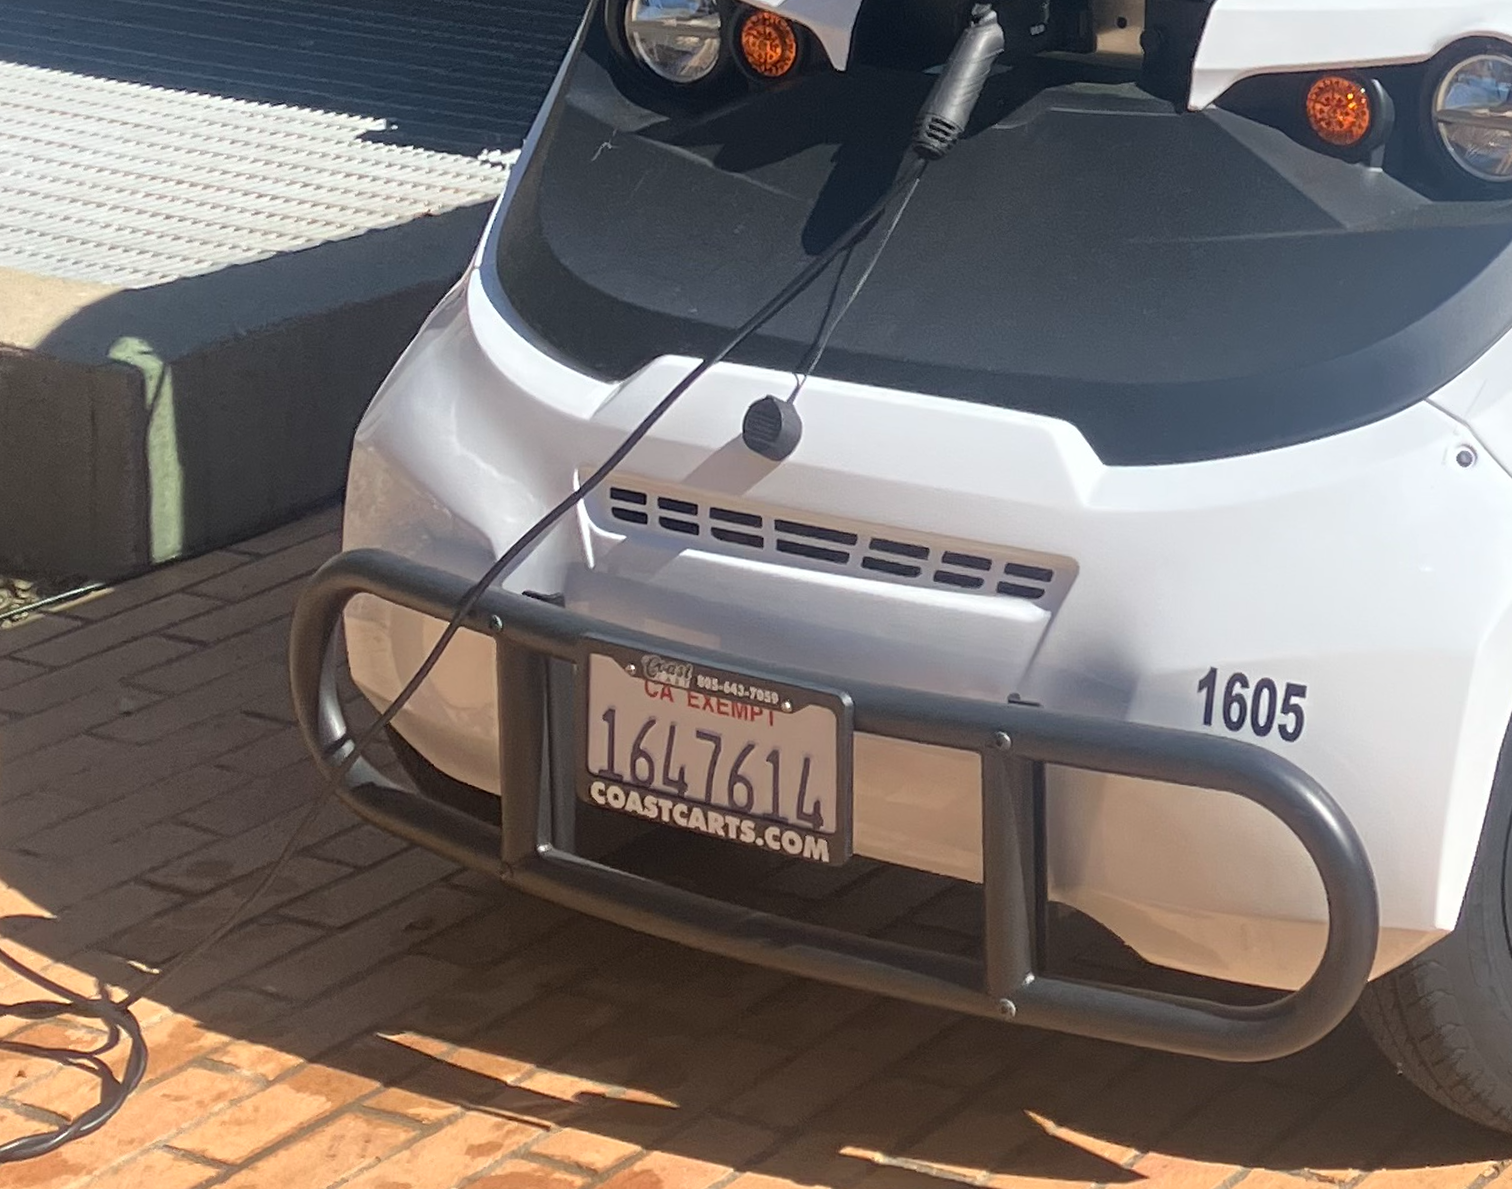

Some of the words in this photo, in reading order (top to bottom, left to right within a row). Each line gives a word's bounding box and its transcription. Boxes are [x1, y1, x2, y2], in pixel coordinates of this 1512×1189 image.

[644, 681, 674, 703] CA
[697, 674, 780, 705] 805-643-7059
[1197, 666, 1307, 742] 1605
[599, 708, 825, 830] 1647614
[589, 781, 830, 862] COASTCARTS.COM
